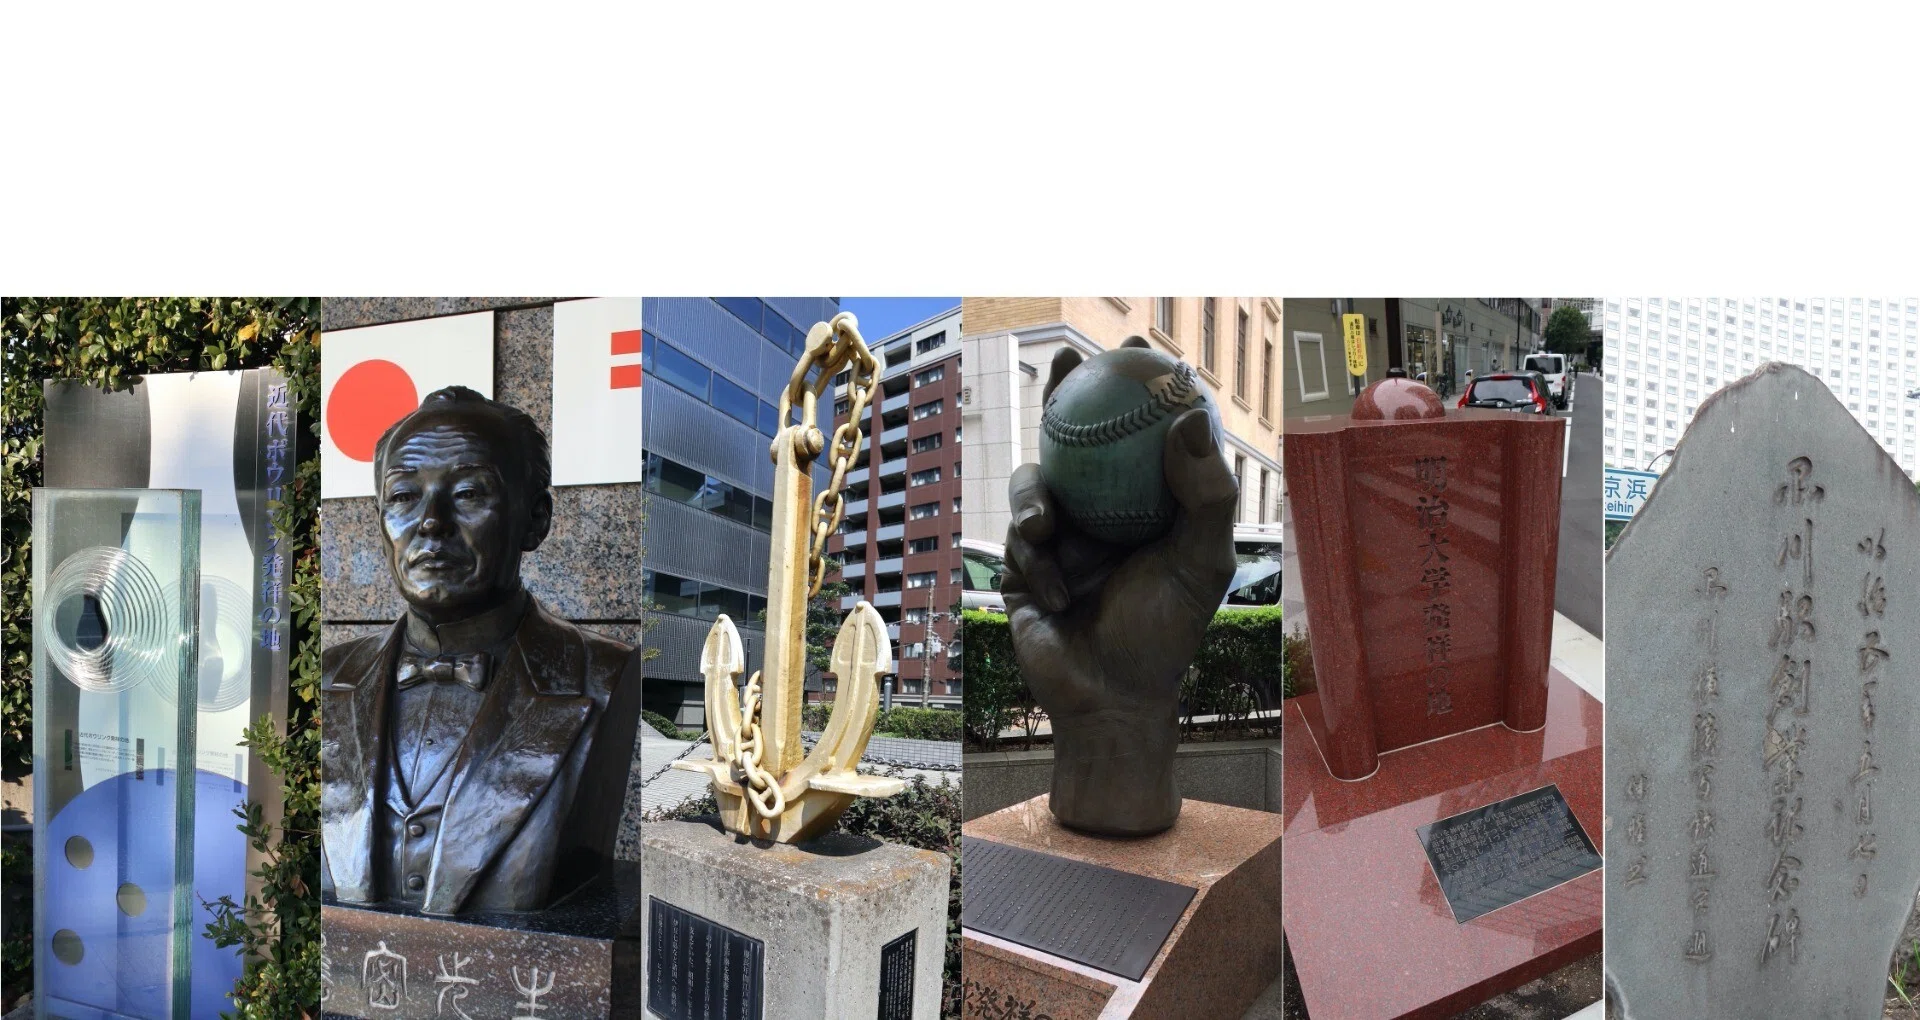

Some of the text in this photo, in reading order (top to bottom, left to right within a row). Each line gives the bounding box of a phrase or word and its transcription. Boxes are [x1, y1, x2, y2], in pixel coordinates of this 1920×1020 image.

[1605, 475, 1647, 502] 京浜
[1605, 500, 1634, 514] eihin
[1414, 454, 1453, 716] 明治大学発祥の地
[963, 976, 1053, 1020] 発祥
